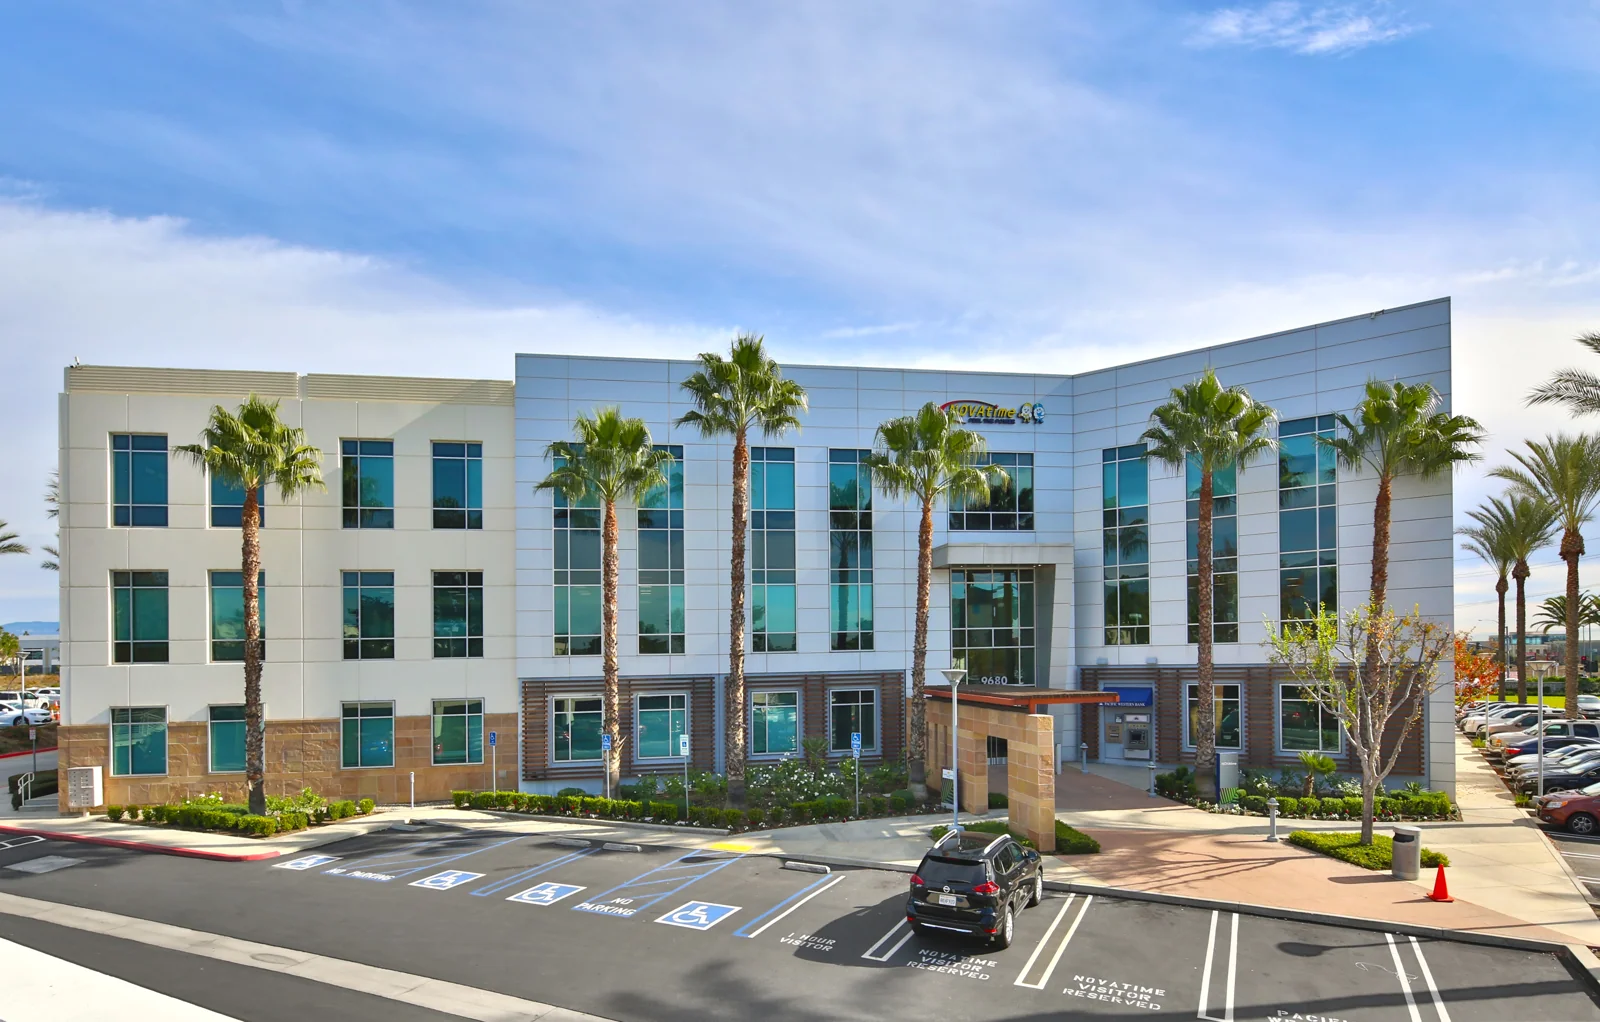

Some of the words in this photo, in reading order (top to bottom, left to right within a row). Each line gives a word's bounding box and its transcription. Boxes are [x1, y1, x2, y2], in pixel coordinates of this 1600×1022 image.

[981, 676, 1008, 686] 9680
[610, 897, 634, 905] NO
[573, 902, 637, 916] PARKING
[780, 937, 833, 952] VISITOR
[799, 934, 837, 945] HOUR
[906, 960, 990, 980] RESERVED
[921, 956, 983, 972] VISITOR
[1073, 974, 1166, 997] NOVATIME
[1079, 983, 1151, 1002] VISITOR
[1062, 988, 1161, 1010] RESERVED
